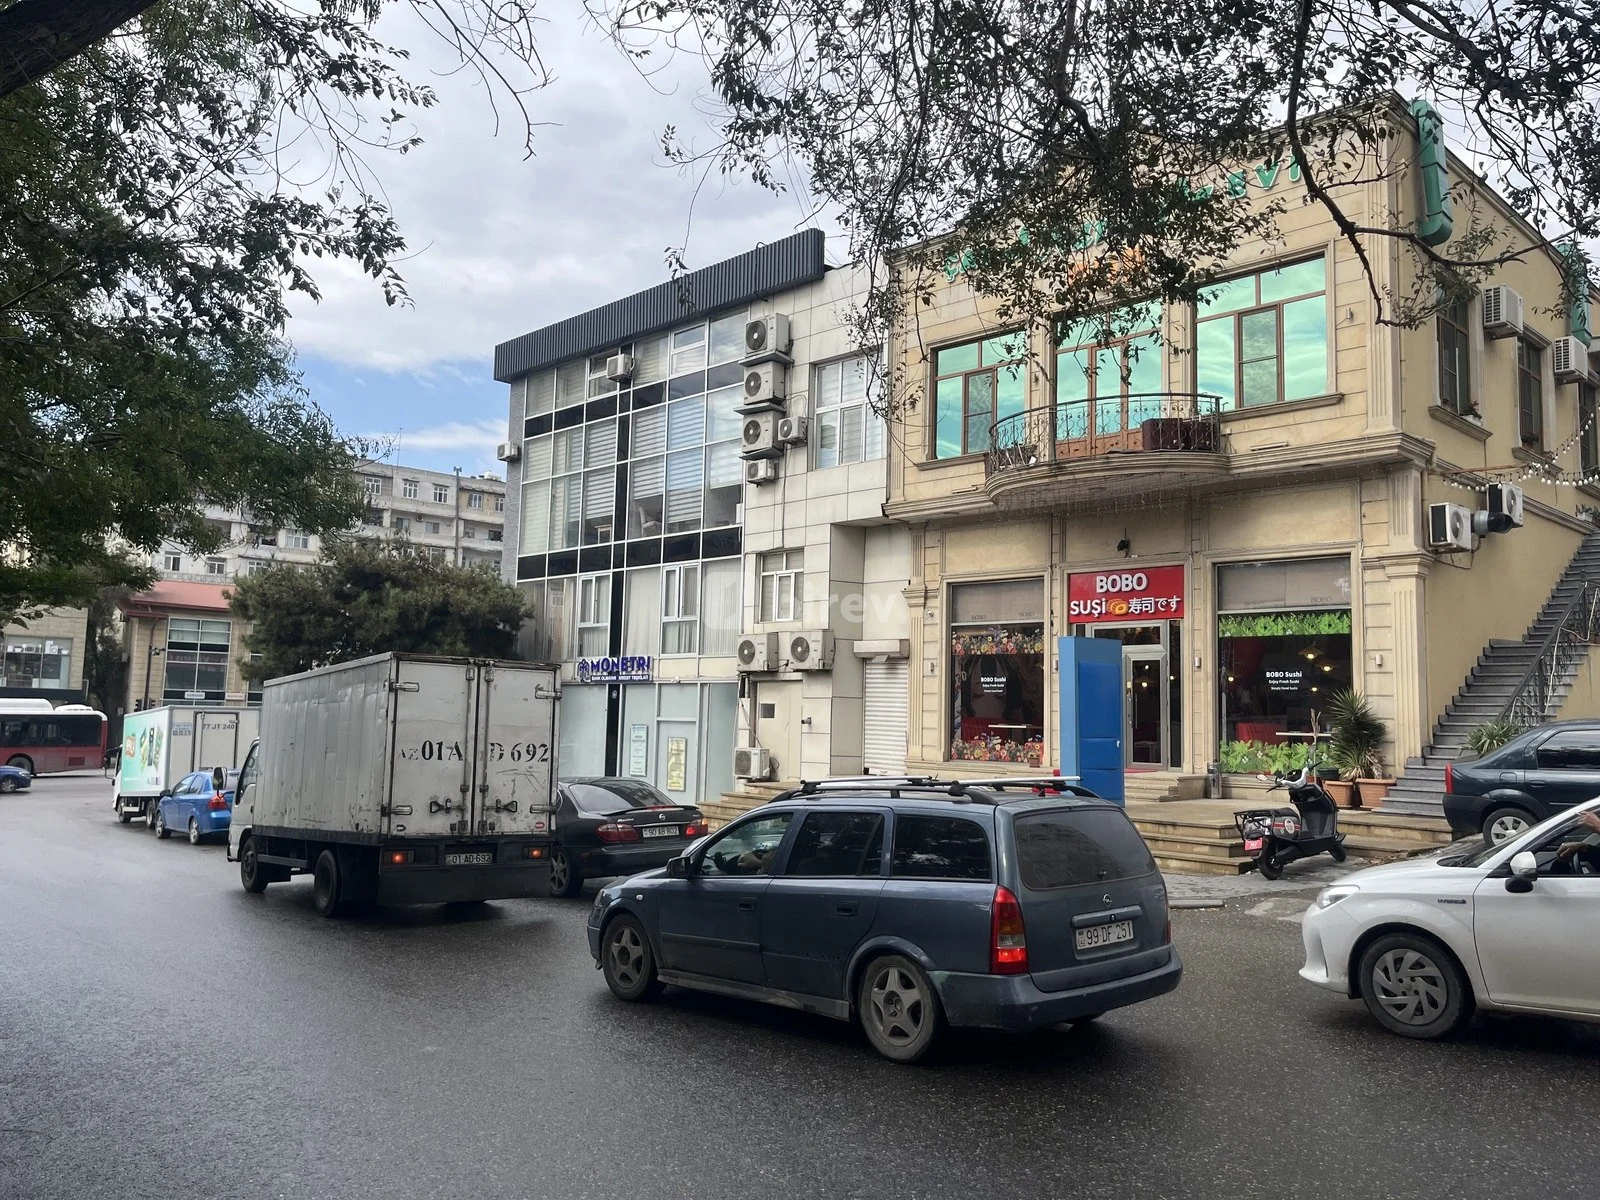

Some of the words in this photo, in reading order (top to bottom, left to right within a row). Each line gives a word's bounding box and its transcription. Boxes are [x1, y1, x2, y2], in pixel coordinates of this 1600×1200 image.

[1096, 572, 1148, 594] BOBO
[1128, 595, 1181, 614] 寿司です
[1284, 670, 1303, 678] Sushi
[510, 742, 549, 762] 692
[648, 828, 657, 836] 90
[658, 827, 665, 835] AB
[1086, 928, 1099, 945] 99
[1101, 925, 1113, 942] DF
[1116, 921, 1132, 940] 251
